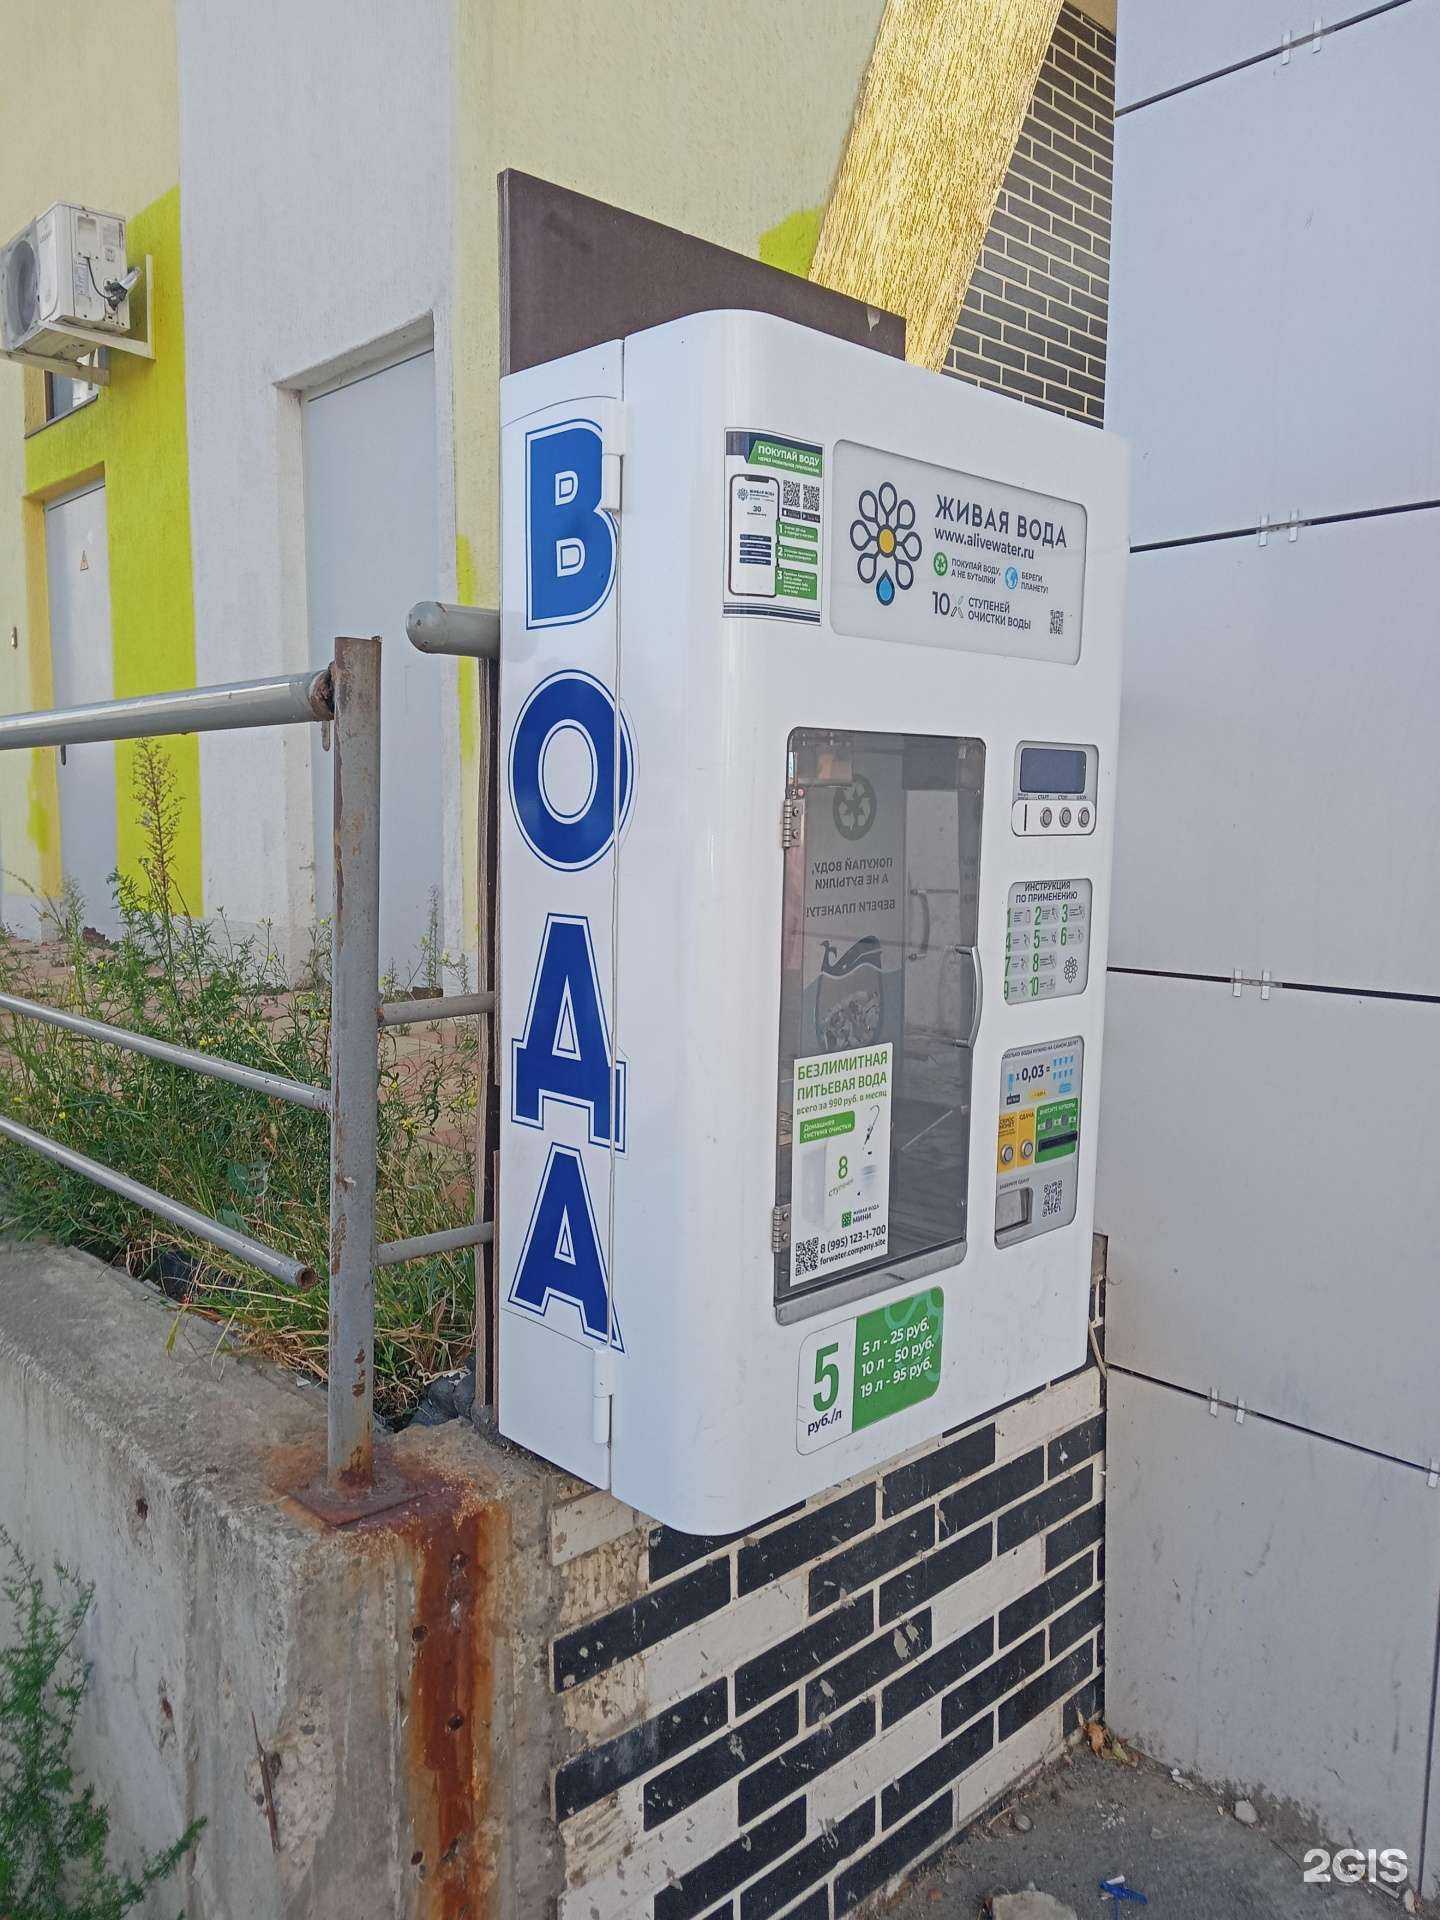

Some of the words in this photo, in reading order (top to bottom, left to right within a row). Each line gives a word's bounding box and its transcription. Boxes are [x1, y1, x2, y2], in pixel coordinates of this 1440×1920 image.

[758, 445, 797, 461] ПОКУПАЙ
[799, 454, 820, 466] ВОДУ
[935, 494, 1009, 534] ЖИВАЯ
[1017, 515, 1067, 548] ВОДА
[934, 528, 1034, 559] www.alivewater.ru
[951, 558, 982, 572] ПОКУПАЙ
[983, 564, 1001, 576] ВОДУ,
[951, 569, 957, 577] А
[957, 571, 967, 579] НЕ
[967, 572, 996, 585] БУТЫЛКИ
[1021, 571, 1043, 582] БЕРЕГИ
[1021, 582, 1049, 594] ПЛАНЕТУ!
[932, 591, 950, 616] 10
[968, 597, 1010, 613] СТУПЕНЕЙ
[968, 610, 1006, 626] ОЧИСТКИ
[1007, 617, 1032, 630] ВОДЫ
[507, 418, 633, 1354] ВОДА
[1024, 881, 1071, 892] ИНСТРУКЦИЯ
[1016, 894, 1027, 903] ПО
[1028, 891, 1078, 903] ПРИМЕНЕНИЮ
[1034, 906, 1042, 925] 2
[1061, 904, 1068, 923] 3
[1034, 930, 1041, 949] 5
[1061, 927, 1067, 946] 6
[1033, 953, 1040, 972] 8
[1030, 977, 1039, 996] 10
[798, 1051, 888, 1080] БЕЗЛИМИТНАЯ
[1021, 1065, 1045, 1083] 0,03
[797, 1077, 856, 1101] ПИТЬЕВАЯ
[858, 1071, 887, 1088] ВОДА
[797, 1103, 818, 1115] всего
[828, 1097, 843, 1109] 990
[843, 1093, 857, 1108] руб.
[865, 1090, 887, 1100] месяц
[838, 1155, 848, 1179] 8
[820, 1244, 826, 1254] 8
[827, 1235, 848, 1253] (995)
[849, 1224, 886, 1245] 123-1-700
[819, 1238, 886, 1266] forwater.company.site
[862, 1342, 870, 1356] 5
[872, 1341, 881, 1352] л
[890, 1328, 904, 1345] 25
[906, 1317, 930, 1340] руб.
[862, 1361, 875, 1377] 10
[876, 1359, 885, 1371] л
[894, 1346, 909, 1364] 50
[911, 1335, 935, 1360] руб.
[813, 1342, 840, 1412] 5
[860, 1382, 873, 1398] 19
[875, 1379, 883, 1391] л
[893, 1367, 907, 1385] 95
[909, 1357, 933, 1380] руб.
[807, 1408, 842, 1436] руб./л
